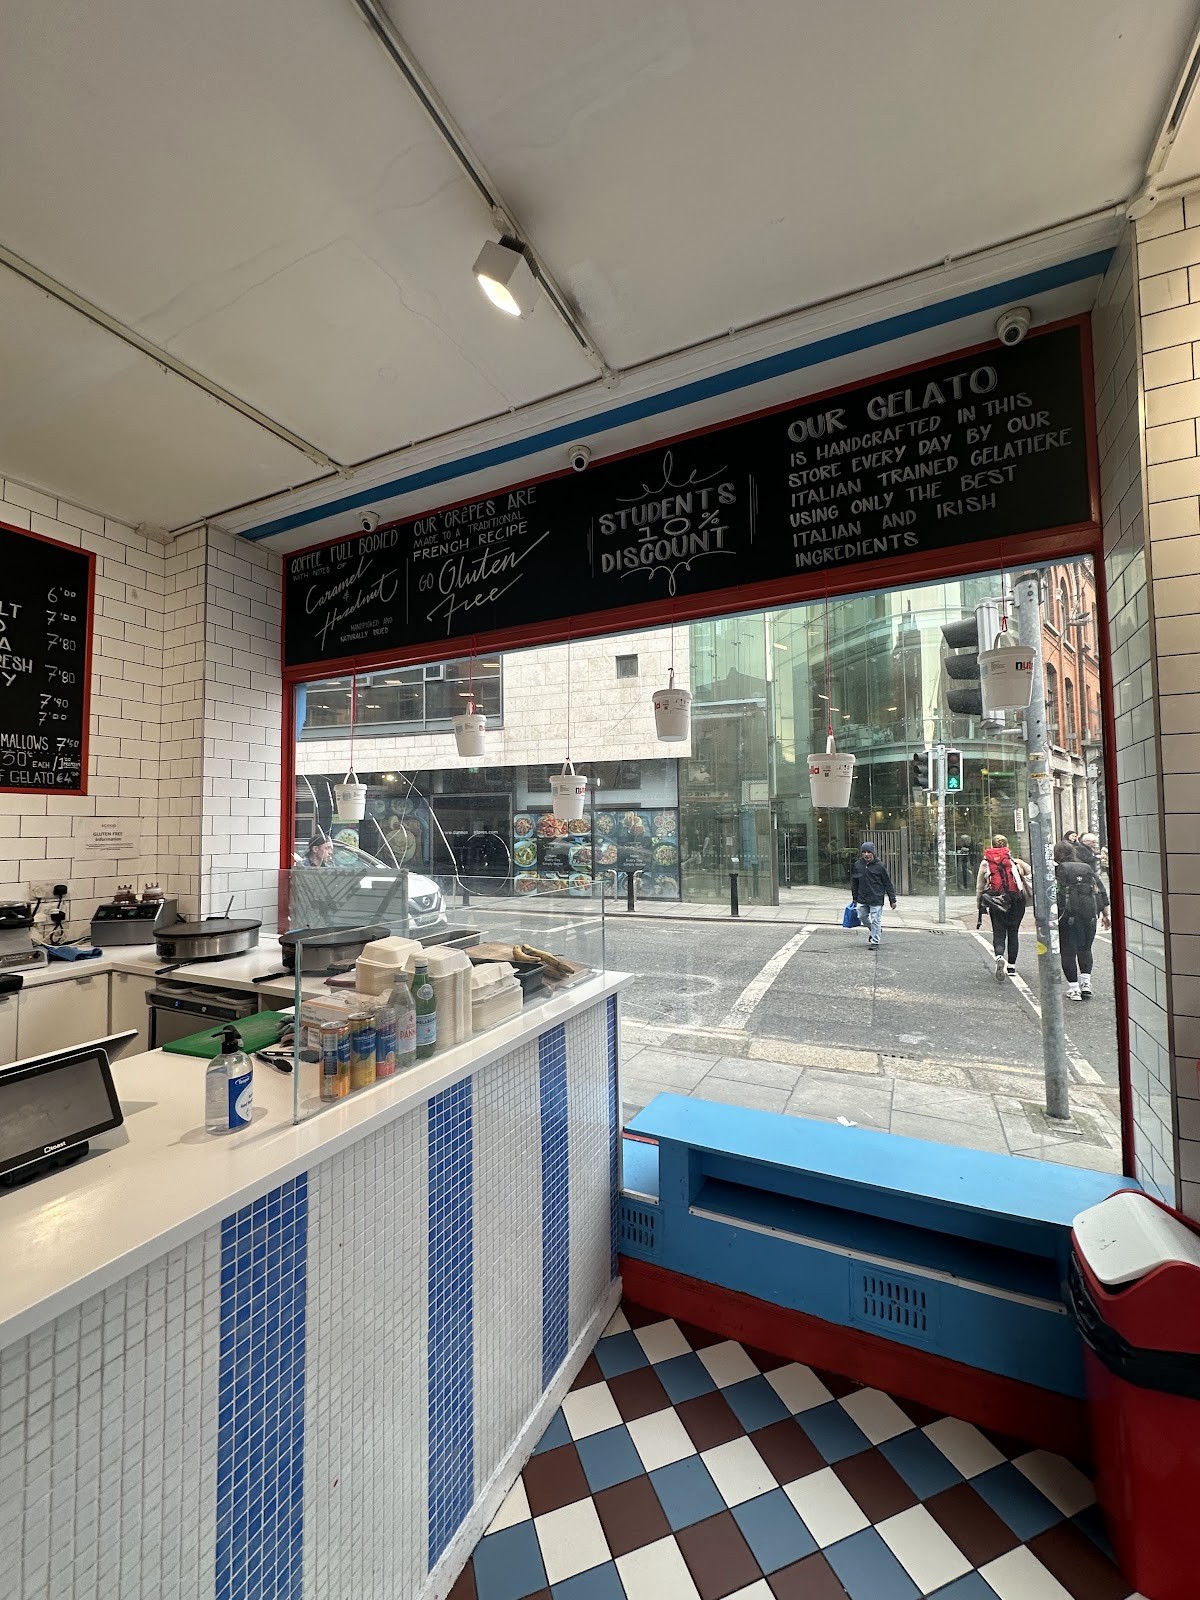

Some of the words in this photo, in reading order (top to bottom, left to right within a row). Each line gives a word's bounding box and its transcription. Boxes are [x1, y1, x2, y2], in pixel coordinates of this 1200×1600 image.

[787, 408, 847, 443] OUR
[866, 365, 998, 421] GELATO
[788, 462, 842, 488] STORE
[852, 445, 907, 473] EVERY
[918, 433, 952, 456] DAY
[966, 424, 992, 445] BY
[1007, 410, 1051, 434] OUR
[790, 451, 807, 468] IS
[816, 415, 941, 461] HANDCRAFTED
[957, 405, 976, 424] IN
[982, 392, 1033, 417] THIS
[791, 478, 862, 508] ITALIAN
[877, 455, 959, 487] TRAINED
[970, 427, 1073, 467] GELATIERE
[413, 516, 437, 537] OUR
[507, 486, 537, 510] ARE
[599, 482, 737, 535] STUDENTS
[789, 505, 839, 528] USING
[850, 492, 894, 515] ONLY
[906, 481, 942, 503] THE
[960, 464, 1018, 492] BEST
[792, 520, 862, 548] ITALIAN
[882, 509, 917, 530] AND
[936, 492, 997, 519] IRISH
[291, 551, 321, 574] COFFEE
[330, 541, 354, 563] FULL
[358, 529, 399, 557] BODIED
[413, 535, 439, 549] MADE
[442, 530, 452, 541] TO
[455, 528, 461, 538] A
[468, 510, 525, 533] TRADITIONAL
[413, 538, 469, 562] FRENCH
[478, 521, 528, 545] RECIPE
[601, 525, 730, 573] DISCOUNT
[795, 531, 919, 568] INGREDIENTS
[292, 571, 310, 582] WITH
[312, 566, 331, 578] NOTES
[337, 562, 348, 570] OF
[305, 556, 373, 615] Caramel
[418, 572, 434, 592] GO
[438, 531, 550, 595] Gluten
[315, 569, 398, 651] Hazelnut
[382, 616, 394, 625] AND
[340, 631, 369, 643] NATURALLY
[2, 671, 17, 687] Y
[0, 733, 49, 751] MALLOWS
[32, 760, 50, 769] EACH
[10, 770, 55, 785] GELATO
